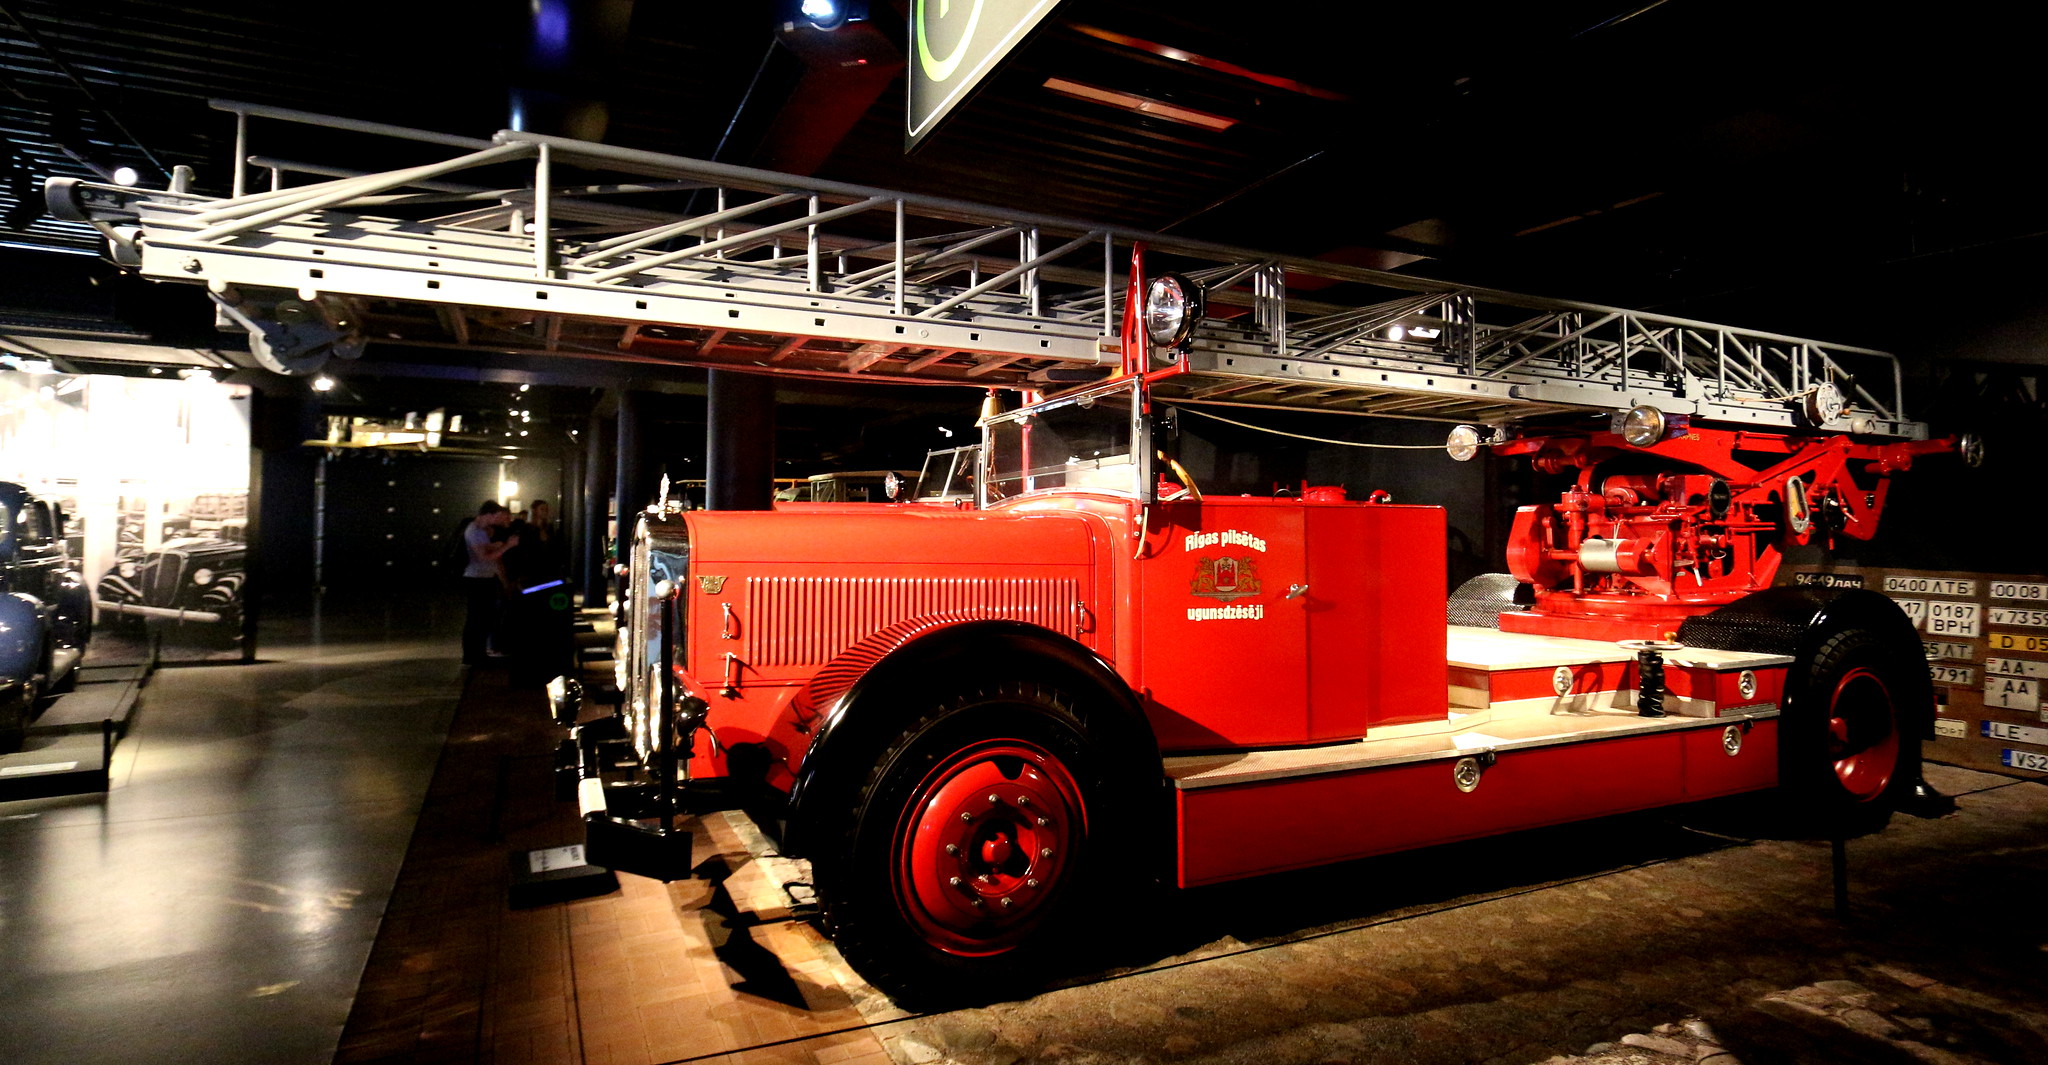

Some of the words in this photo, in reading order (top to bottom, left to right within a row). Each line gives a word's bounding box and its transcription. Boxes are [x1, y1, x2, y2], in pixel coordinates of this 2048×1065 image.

[1185, 531, 1219, 552] Rīgas
[1221, 529, 1266, 552] pilsētas
[1889, 579, 1927, 591] 0400
[1187, 604, 1264, 621] ugunsdzēsēji
[1933, 605, 1974, 619] 0187
[2001, 636, 2014, 649] D
